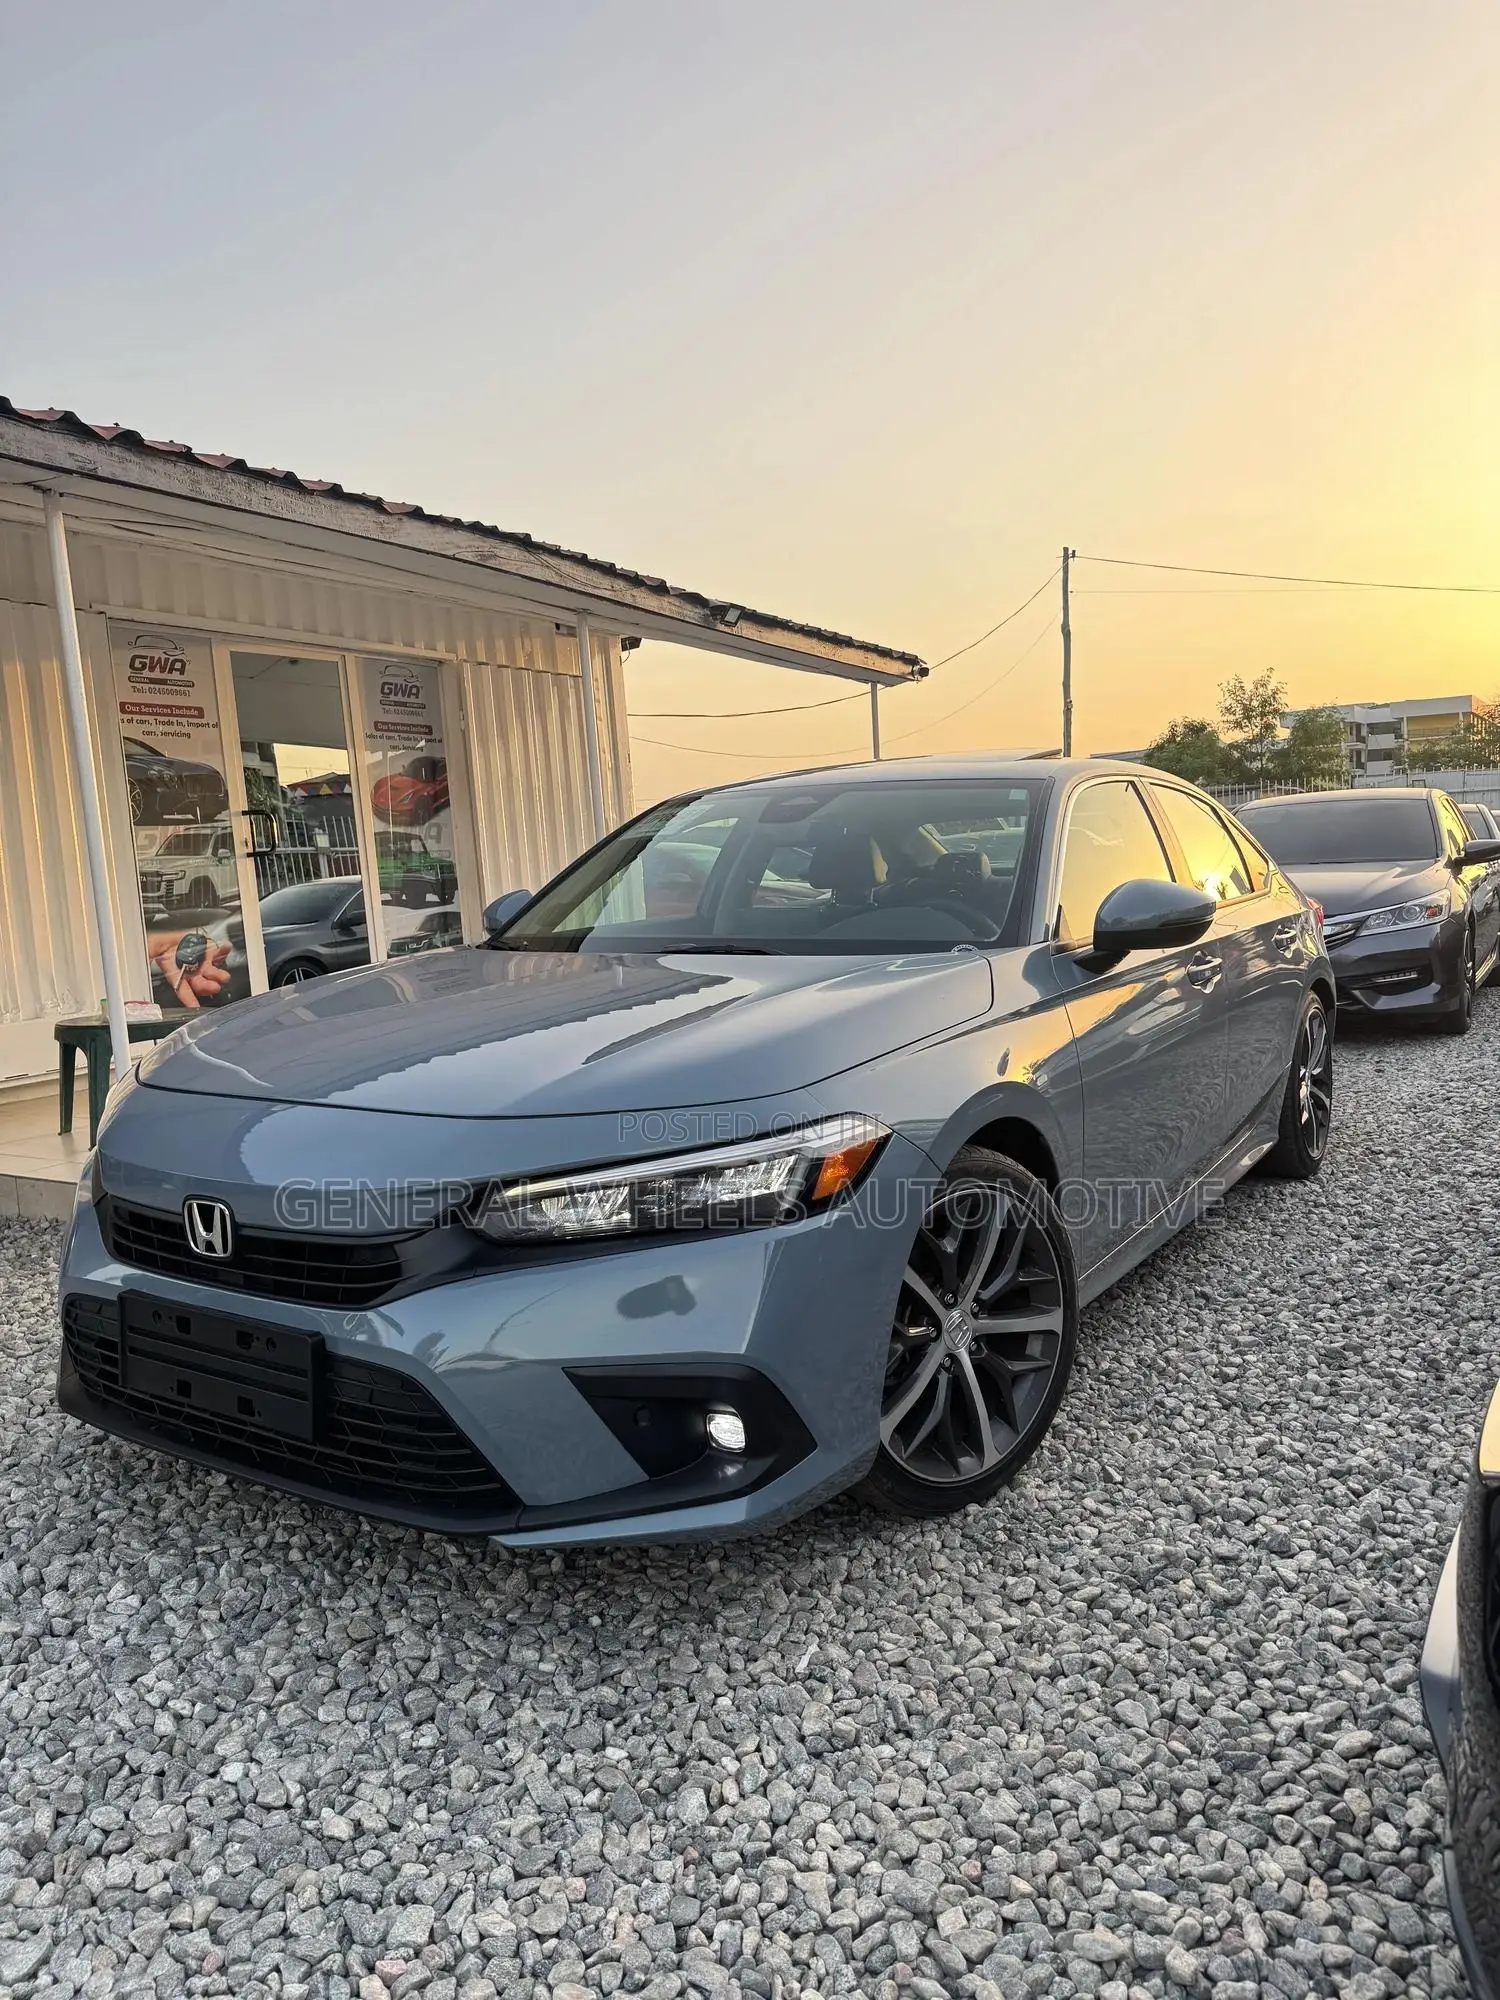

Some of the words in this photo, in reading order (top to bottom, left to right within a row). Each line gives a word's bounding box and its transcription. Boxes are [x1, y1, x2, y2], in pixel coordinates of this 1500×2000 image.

[129, 654, 186, 675] GWA
[131, 686, 147, 694] Tel:
[381, 682, 420, 699] GWA
[125, 704, 139, 712] Our
[141, 705, 171, 714] Services
[172, 707, 199, 716] Include
[153, 718, 175, 727] Trade
